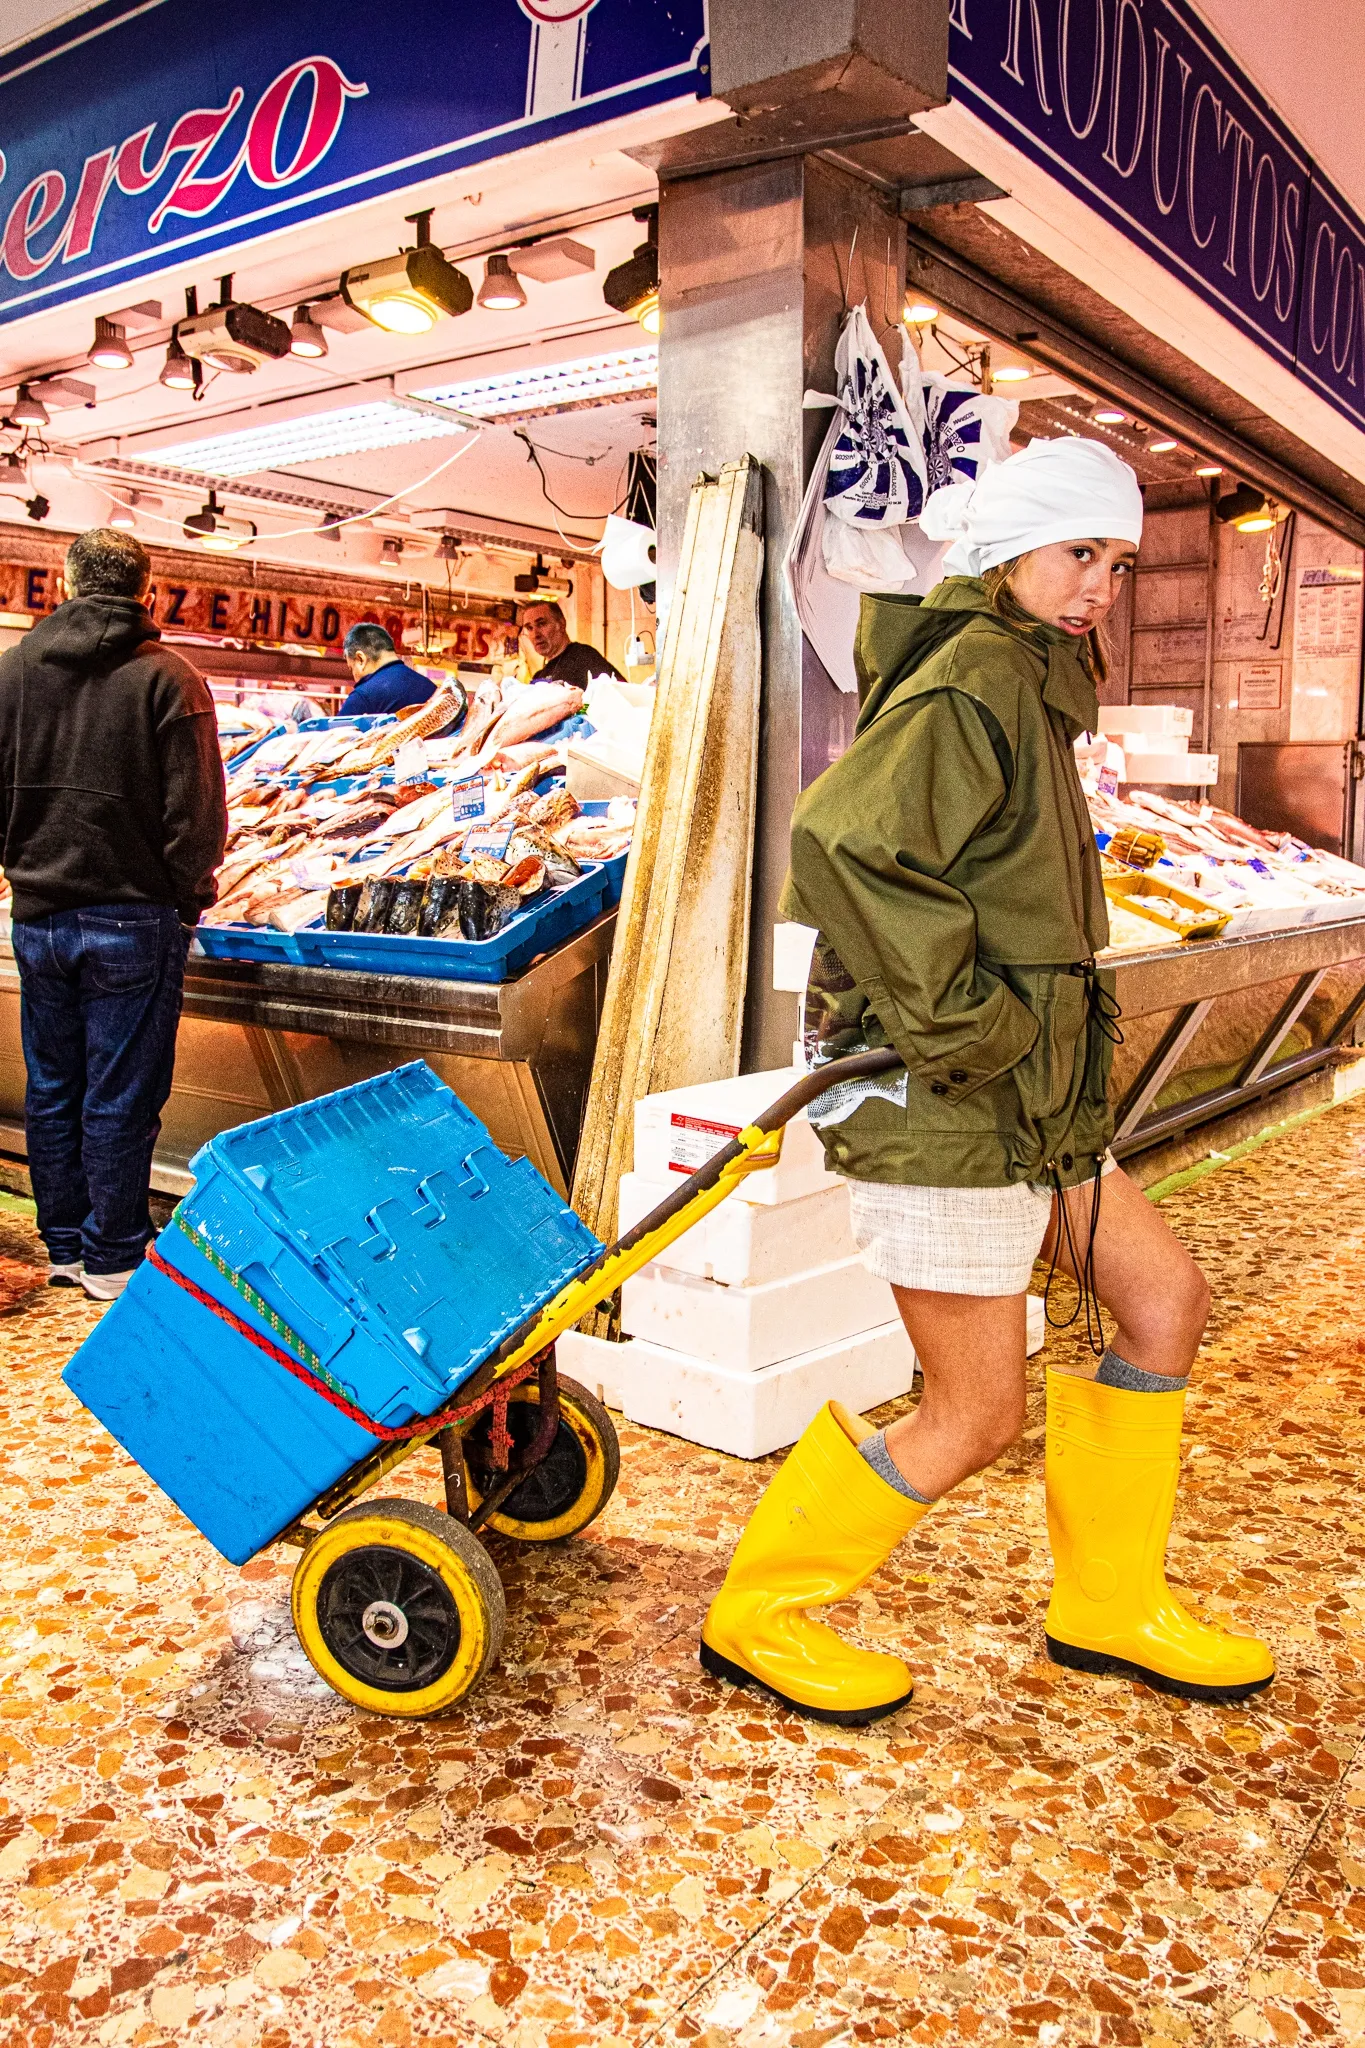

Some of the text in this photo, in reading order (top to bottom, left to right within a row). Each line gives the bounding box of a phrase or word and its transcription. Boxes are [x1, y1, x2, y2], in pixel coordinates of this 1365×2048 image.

[0, 54, 369, 281] erzo
[949, 0, 1300, 322] ODUCTOS
[939, 421, 965, 453] BIERZO
